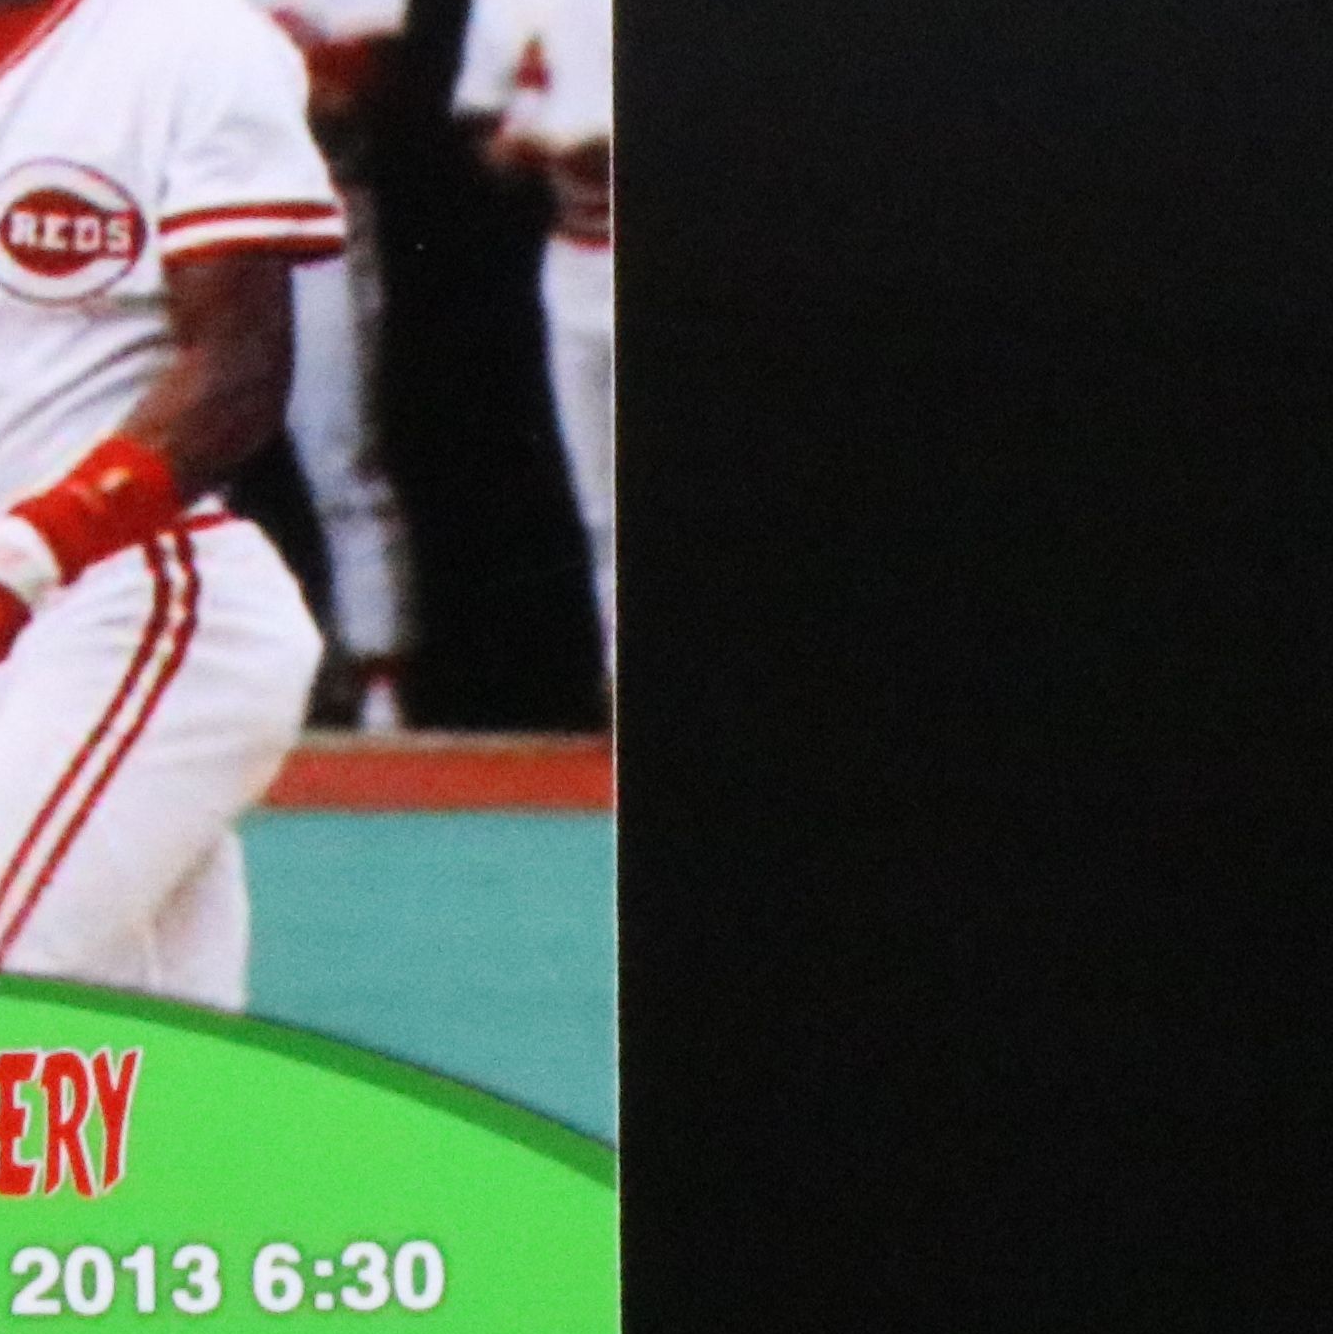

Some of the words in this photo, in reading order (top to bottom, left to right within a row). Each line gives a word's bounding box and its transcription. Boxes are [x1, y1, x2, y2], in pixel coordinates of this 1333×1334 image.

[6, 212, 131, 255] REDS
[12, 1245, 221, 1315] 2013
[253, 1241, 444, 1312] 6:30
